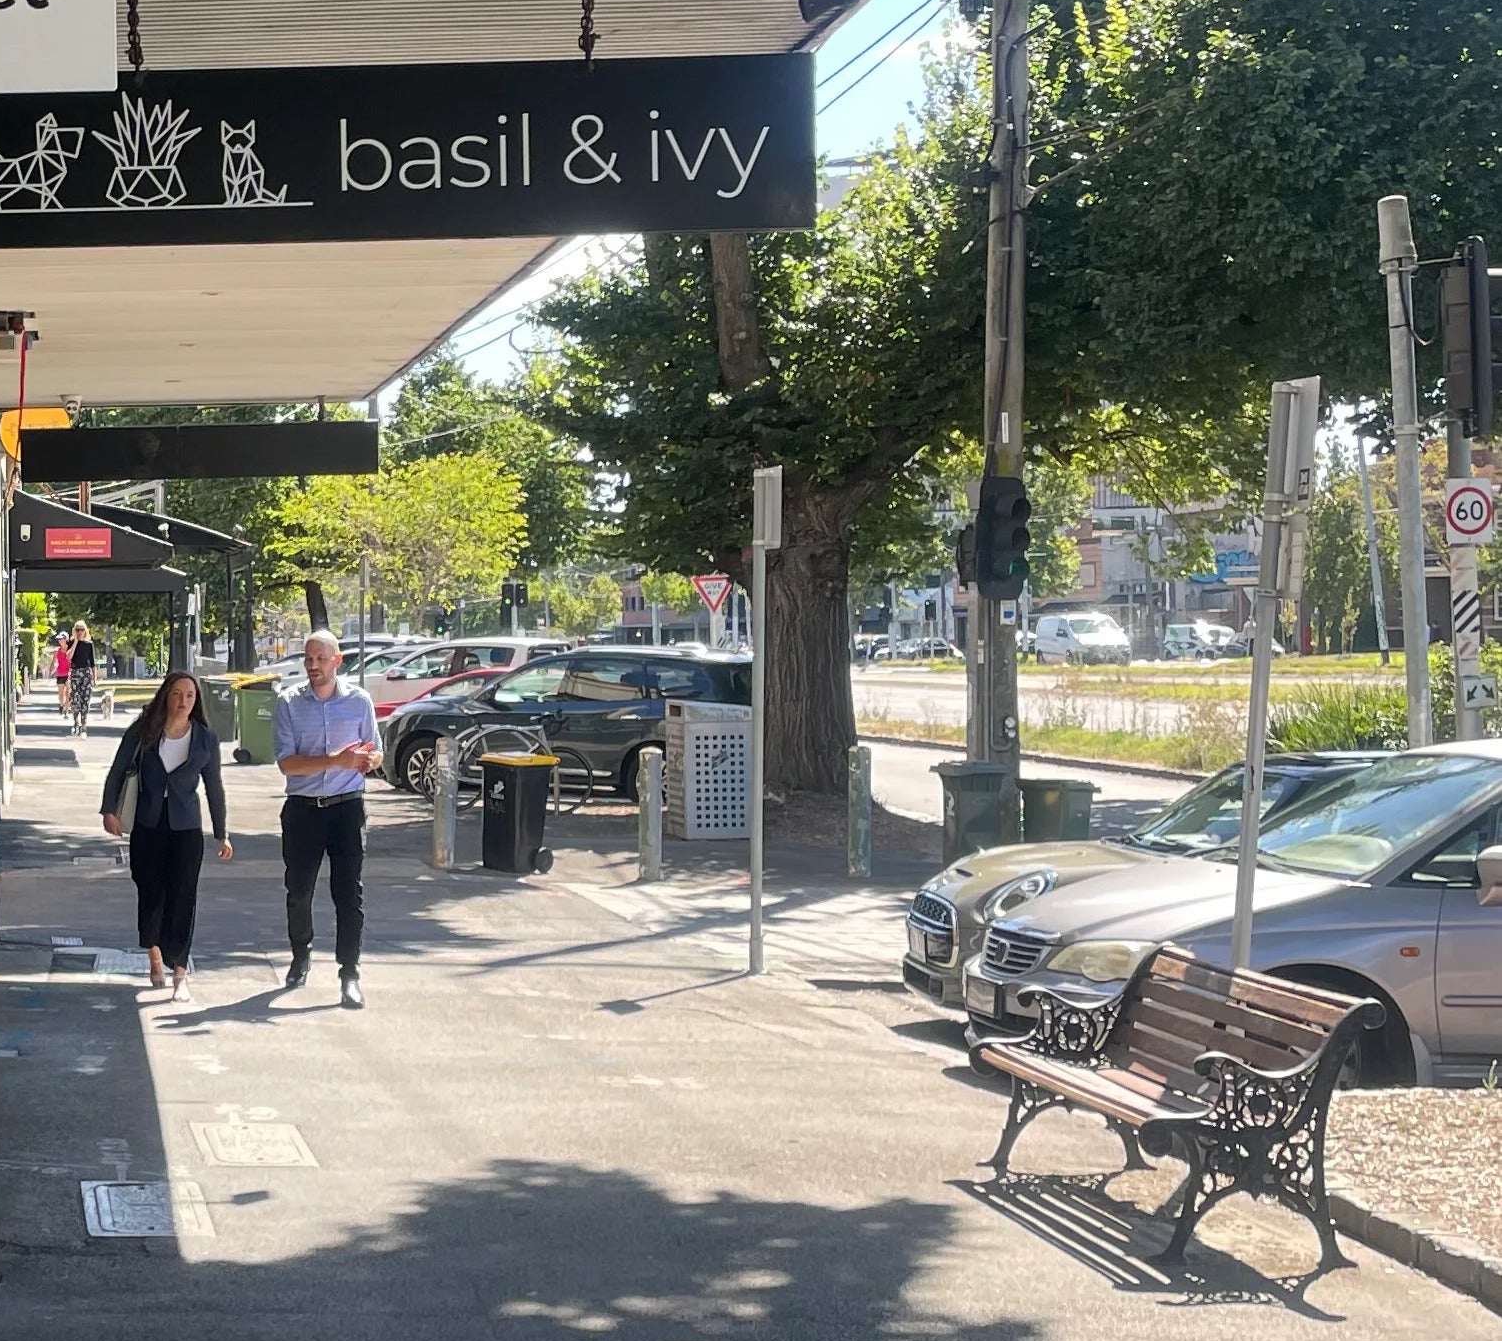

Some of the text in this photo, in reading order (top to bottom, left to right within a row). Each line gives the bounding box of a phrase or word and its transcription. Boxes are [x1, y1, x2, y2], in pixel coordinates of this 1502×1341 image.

[340, 110, 770, 199] basil & ivy
[1456, 500, 1483, 520] 60
